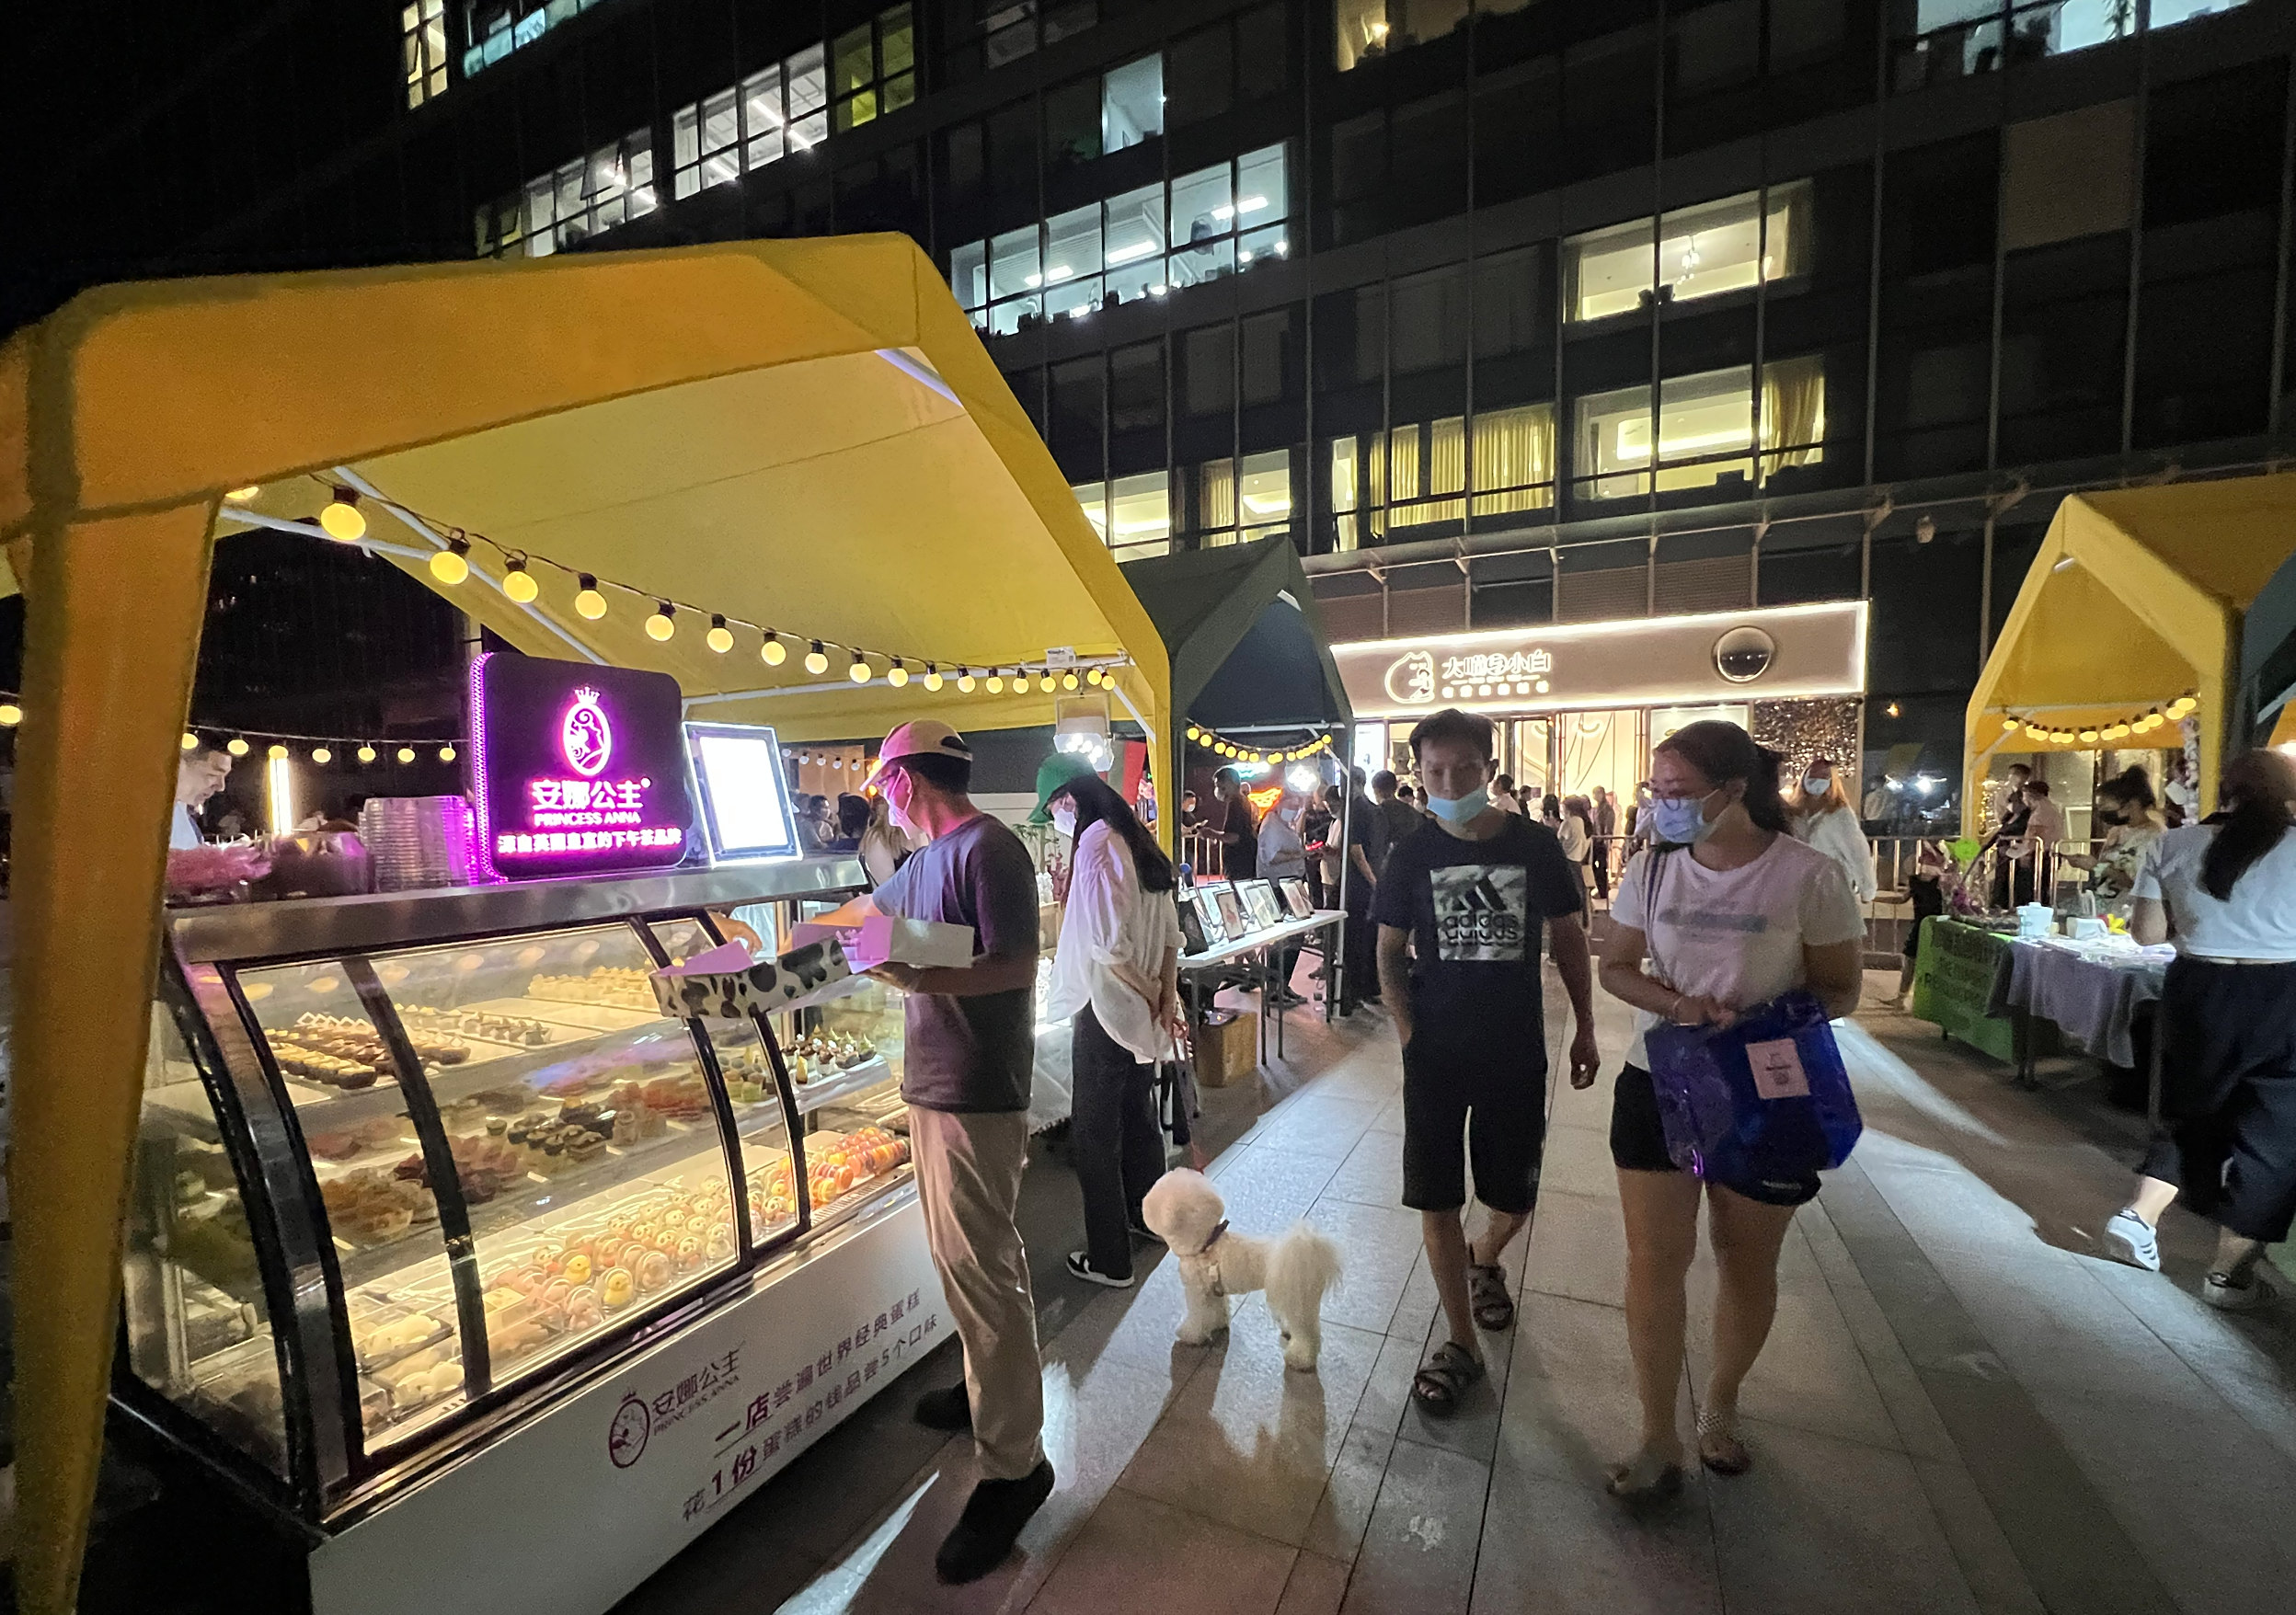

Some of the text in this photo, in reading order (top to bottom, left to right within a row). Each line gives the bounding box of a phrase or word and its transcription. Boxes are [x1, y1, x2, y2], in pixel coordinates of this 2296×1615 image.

[532, 780, 643, 810] 安娜公主
[534, 812, 641, 827] PRINCESS ANNA
[652, 1348, 740, 1423] 安娜公主
